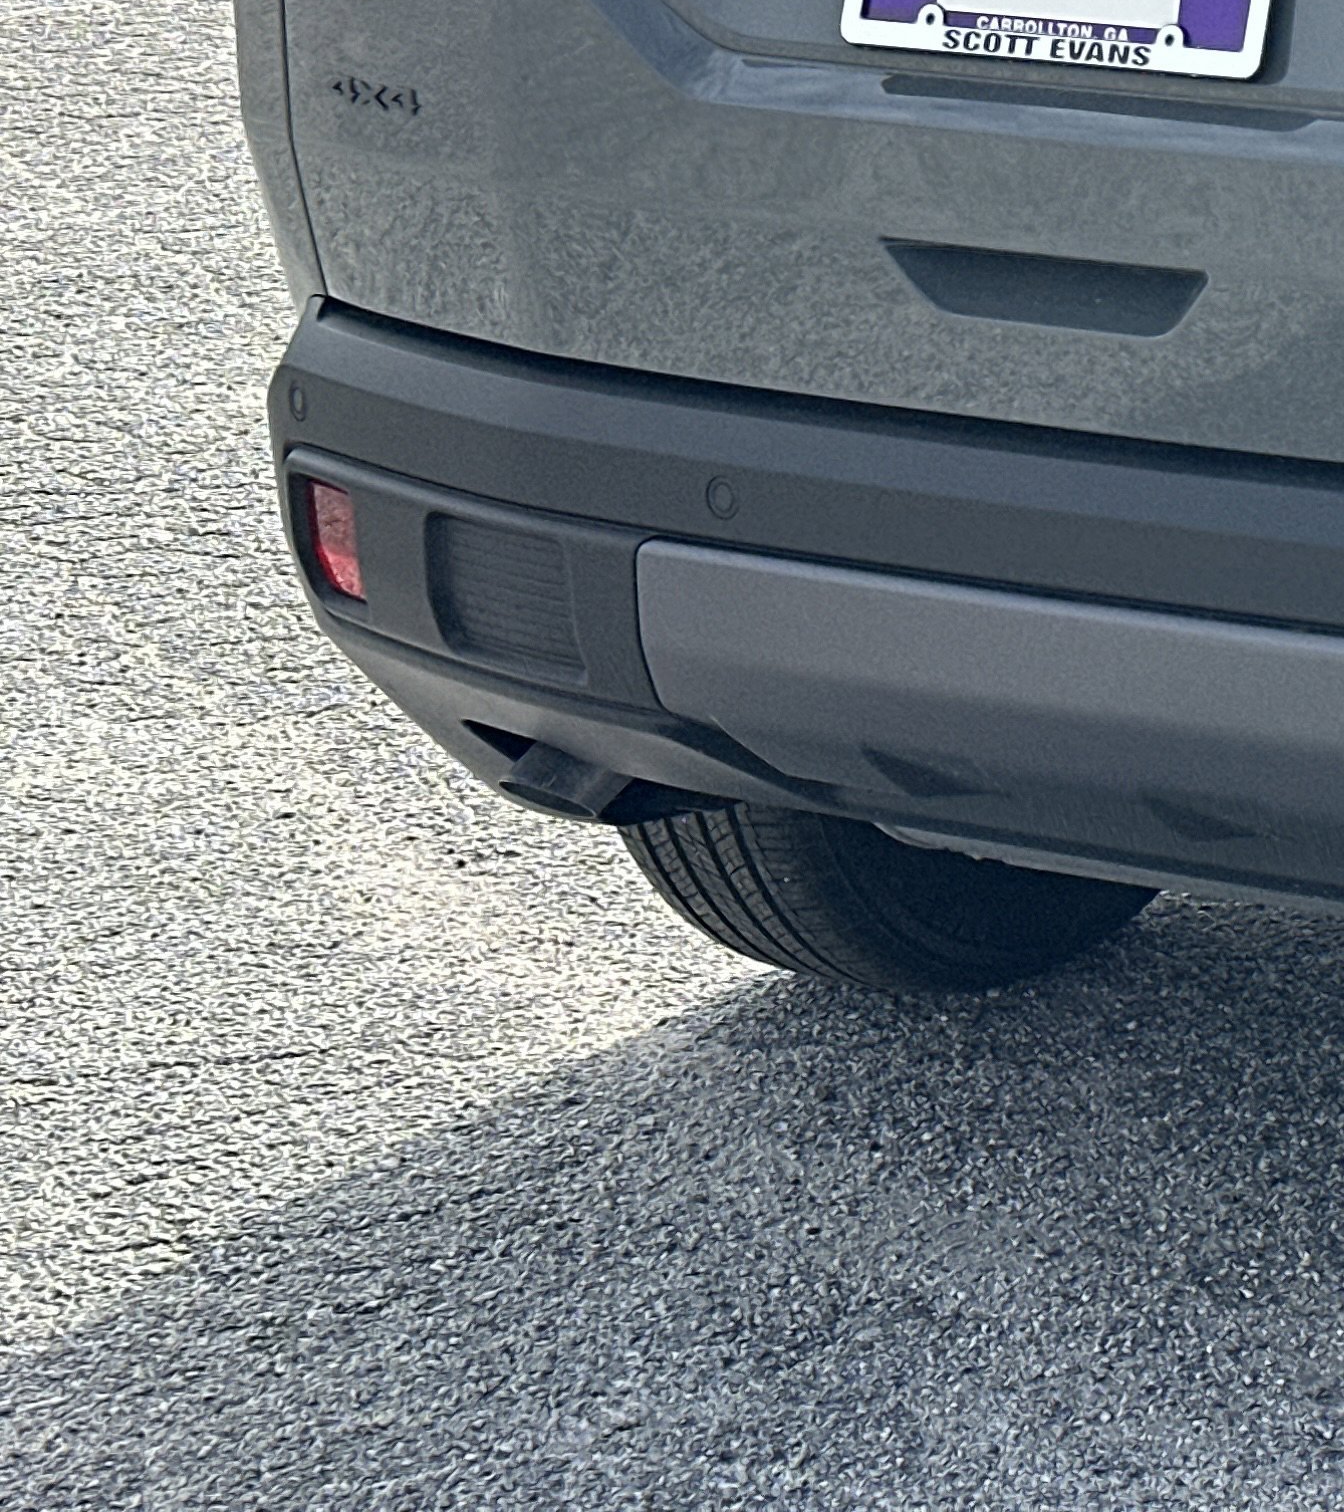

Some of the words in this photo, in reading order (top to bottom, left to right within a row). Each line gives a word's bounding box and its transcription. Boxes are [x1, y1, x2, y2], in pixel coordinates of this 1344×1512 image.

[942, 29, 1040, 56] SCOTT
[1050, 38, 1152, 66] EVANS
[1104, 27, 1128, 42] GA
